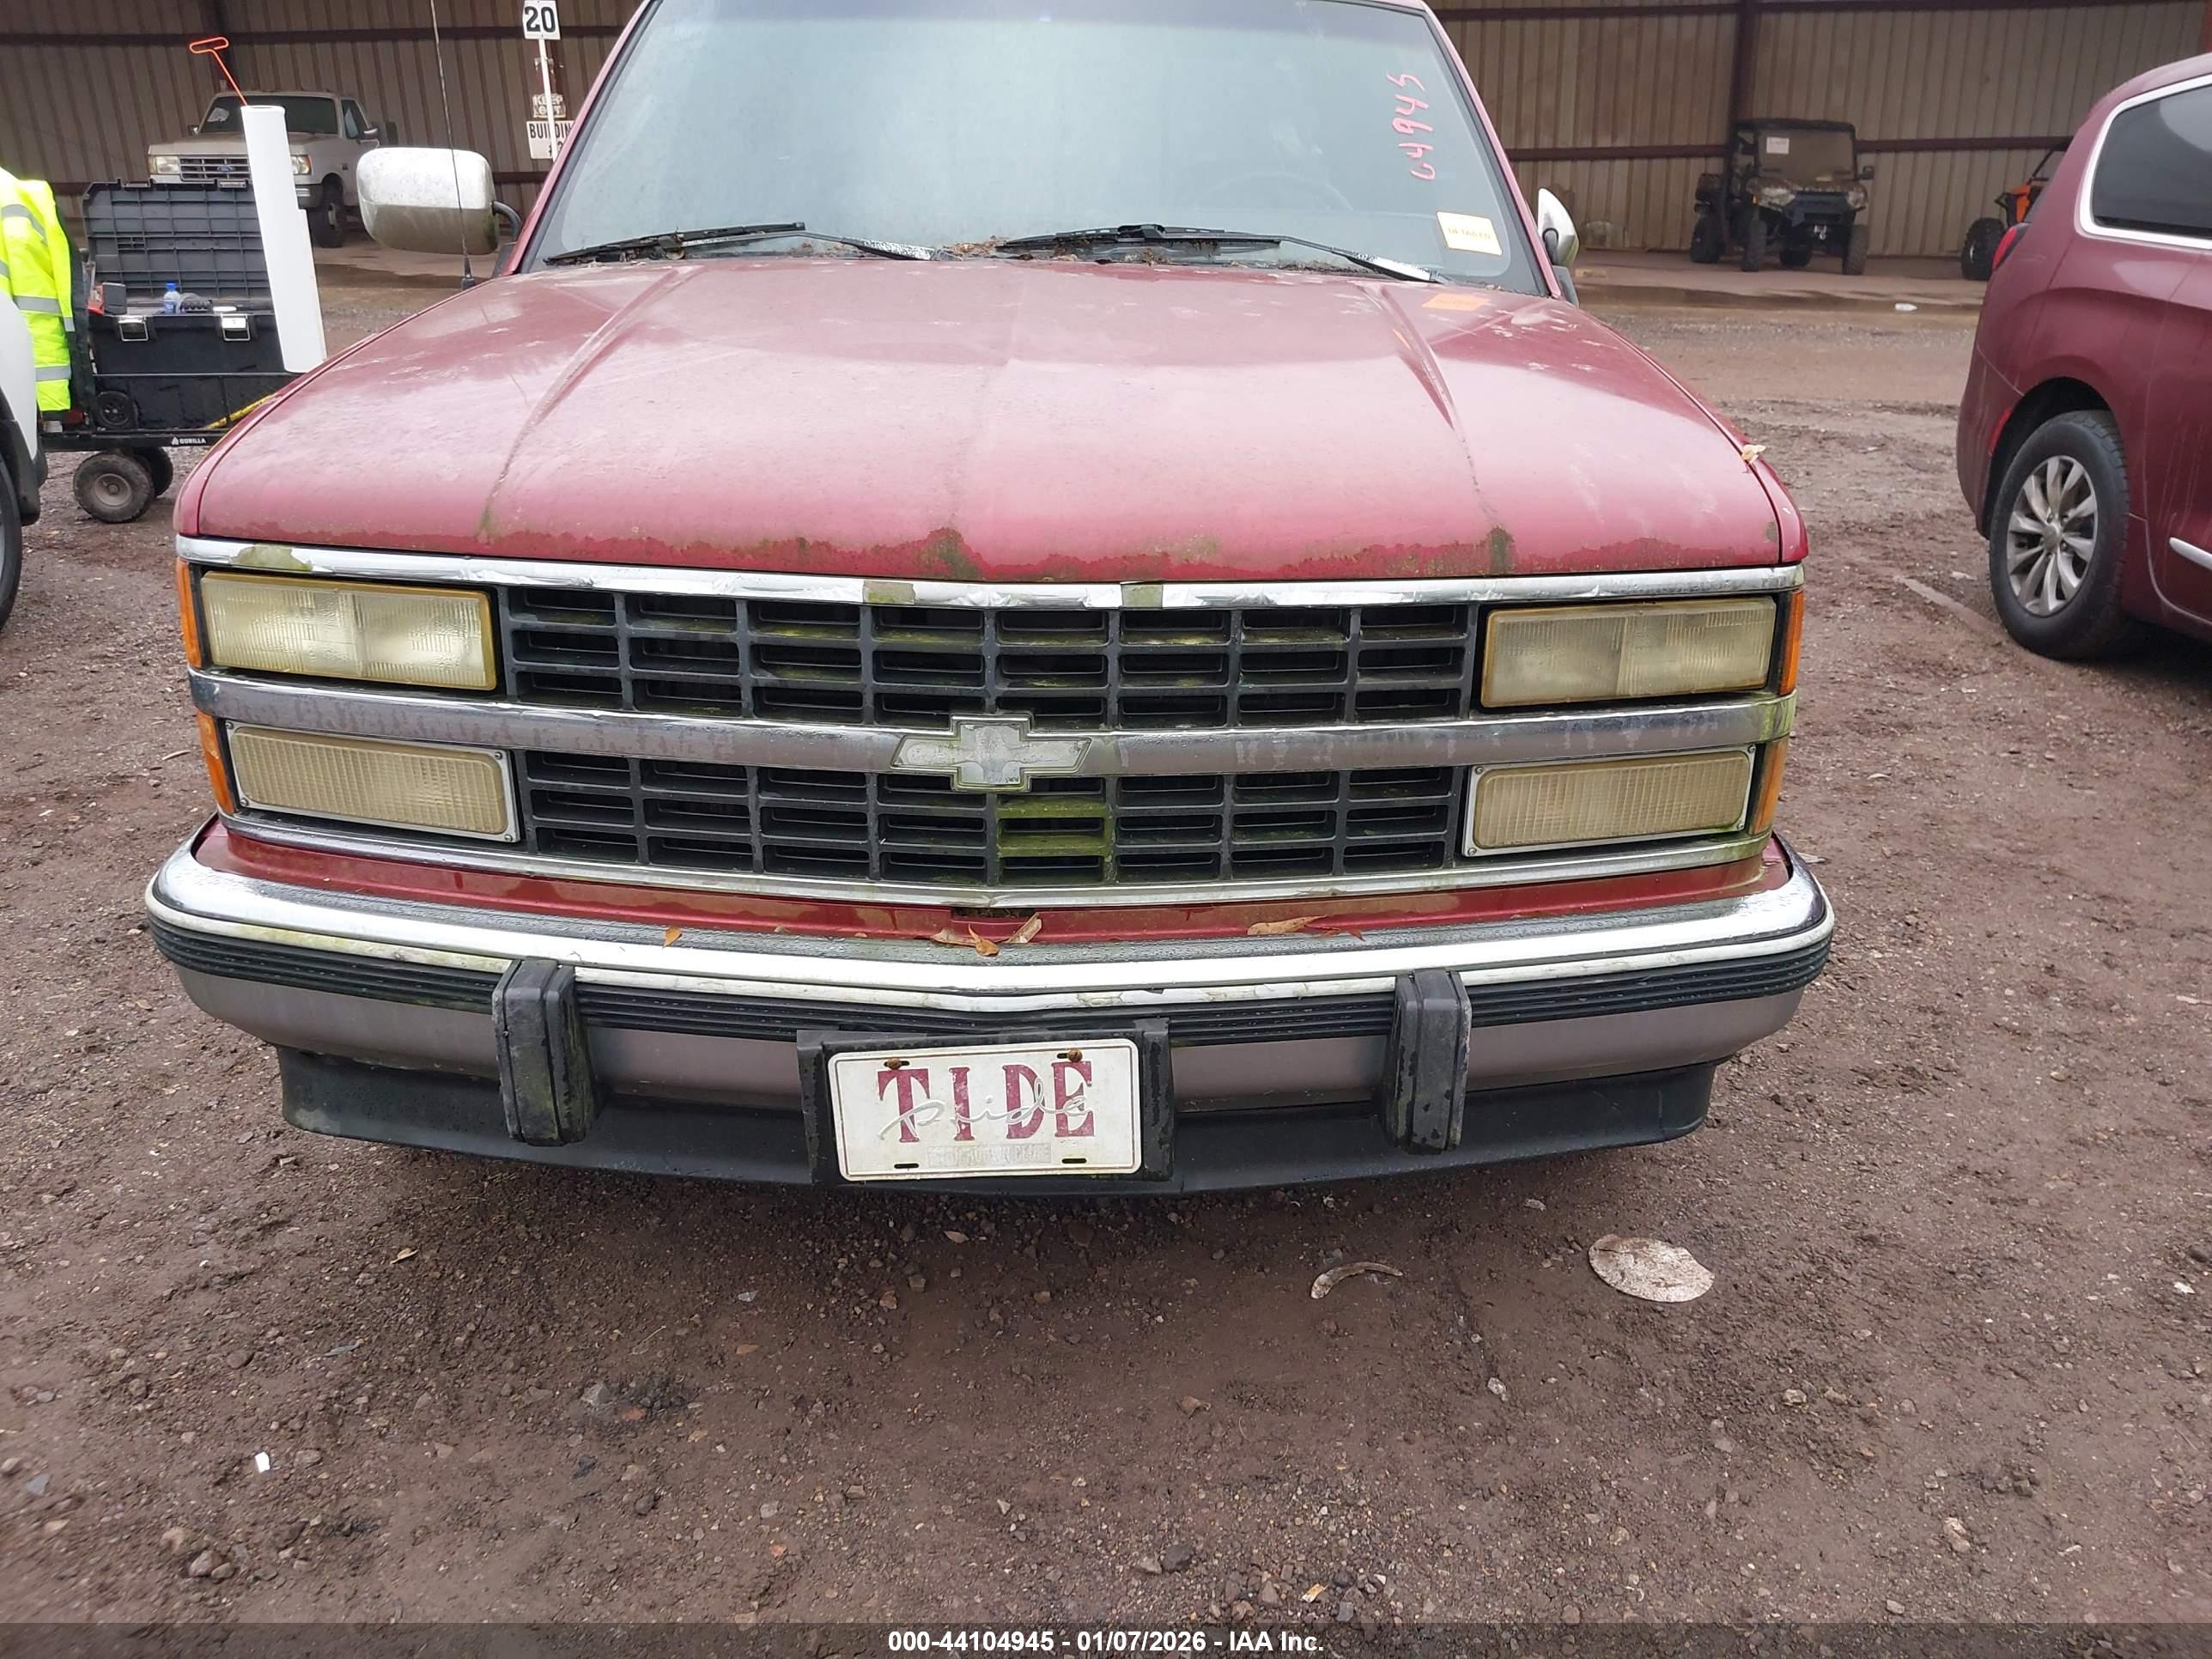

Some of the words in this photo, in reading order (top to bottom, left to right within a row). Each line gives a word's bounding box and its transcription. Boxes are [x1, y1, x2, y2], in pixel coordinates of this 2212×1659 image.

[525, 6, 556, 33] 20
[538, 106, 561, 115] OT
[529, 123, 571, 138] BUIDIN
[877, 1060, 1095, 1143] TIDE
